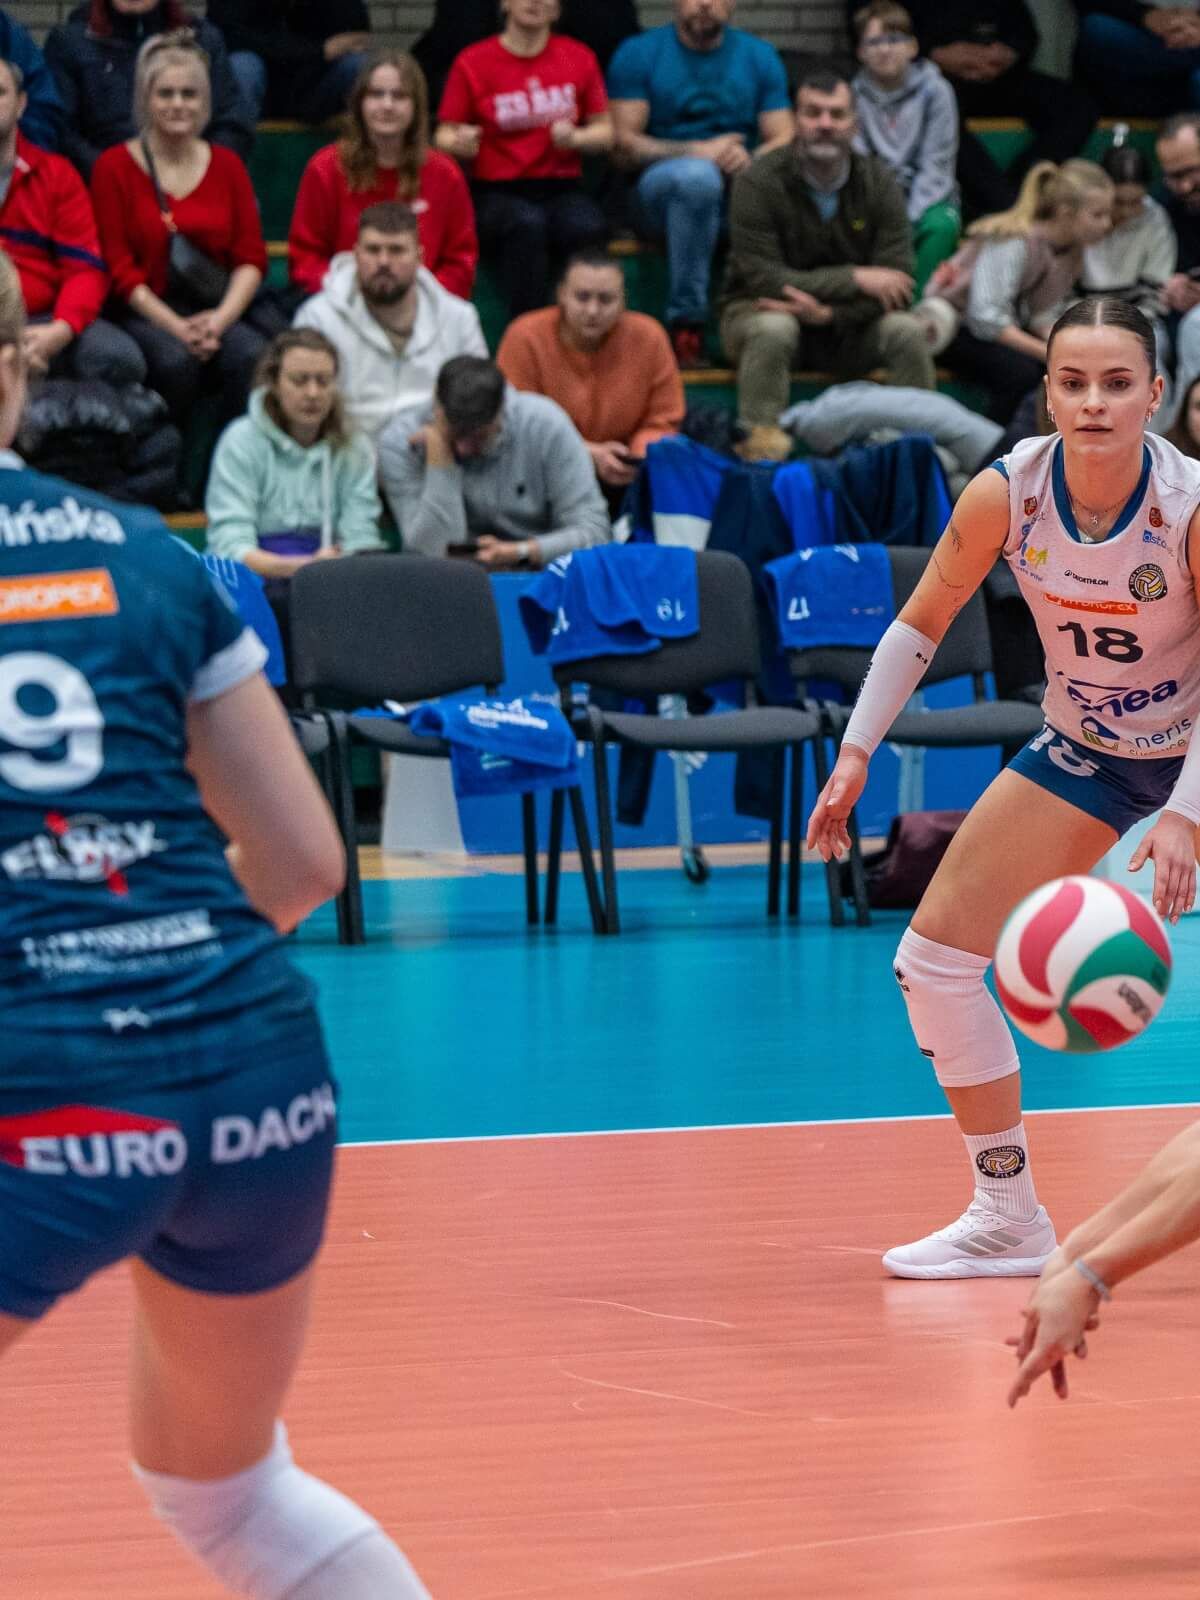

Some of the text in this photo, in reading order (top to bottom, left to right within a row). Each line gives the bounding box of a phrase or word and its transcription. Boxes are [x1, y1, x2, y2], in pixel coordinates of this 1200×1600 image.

[0, 496, 127, 547] ińska
[1056, 621, 1144, 664] 18
[0, 652, 104, 793] 9
[1127, 718, 1192, 748] neris
[20, 1082, 337, 1178] EURO DACH
